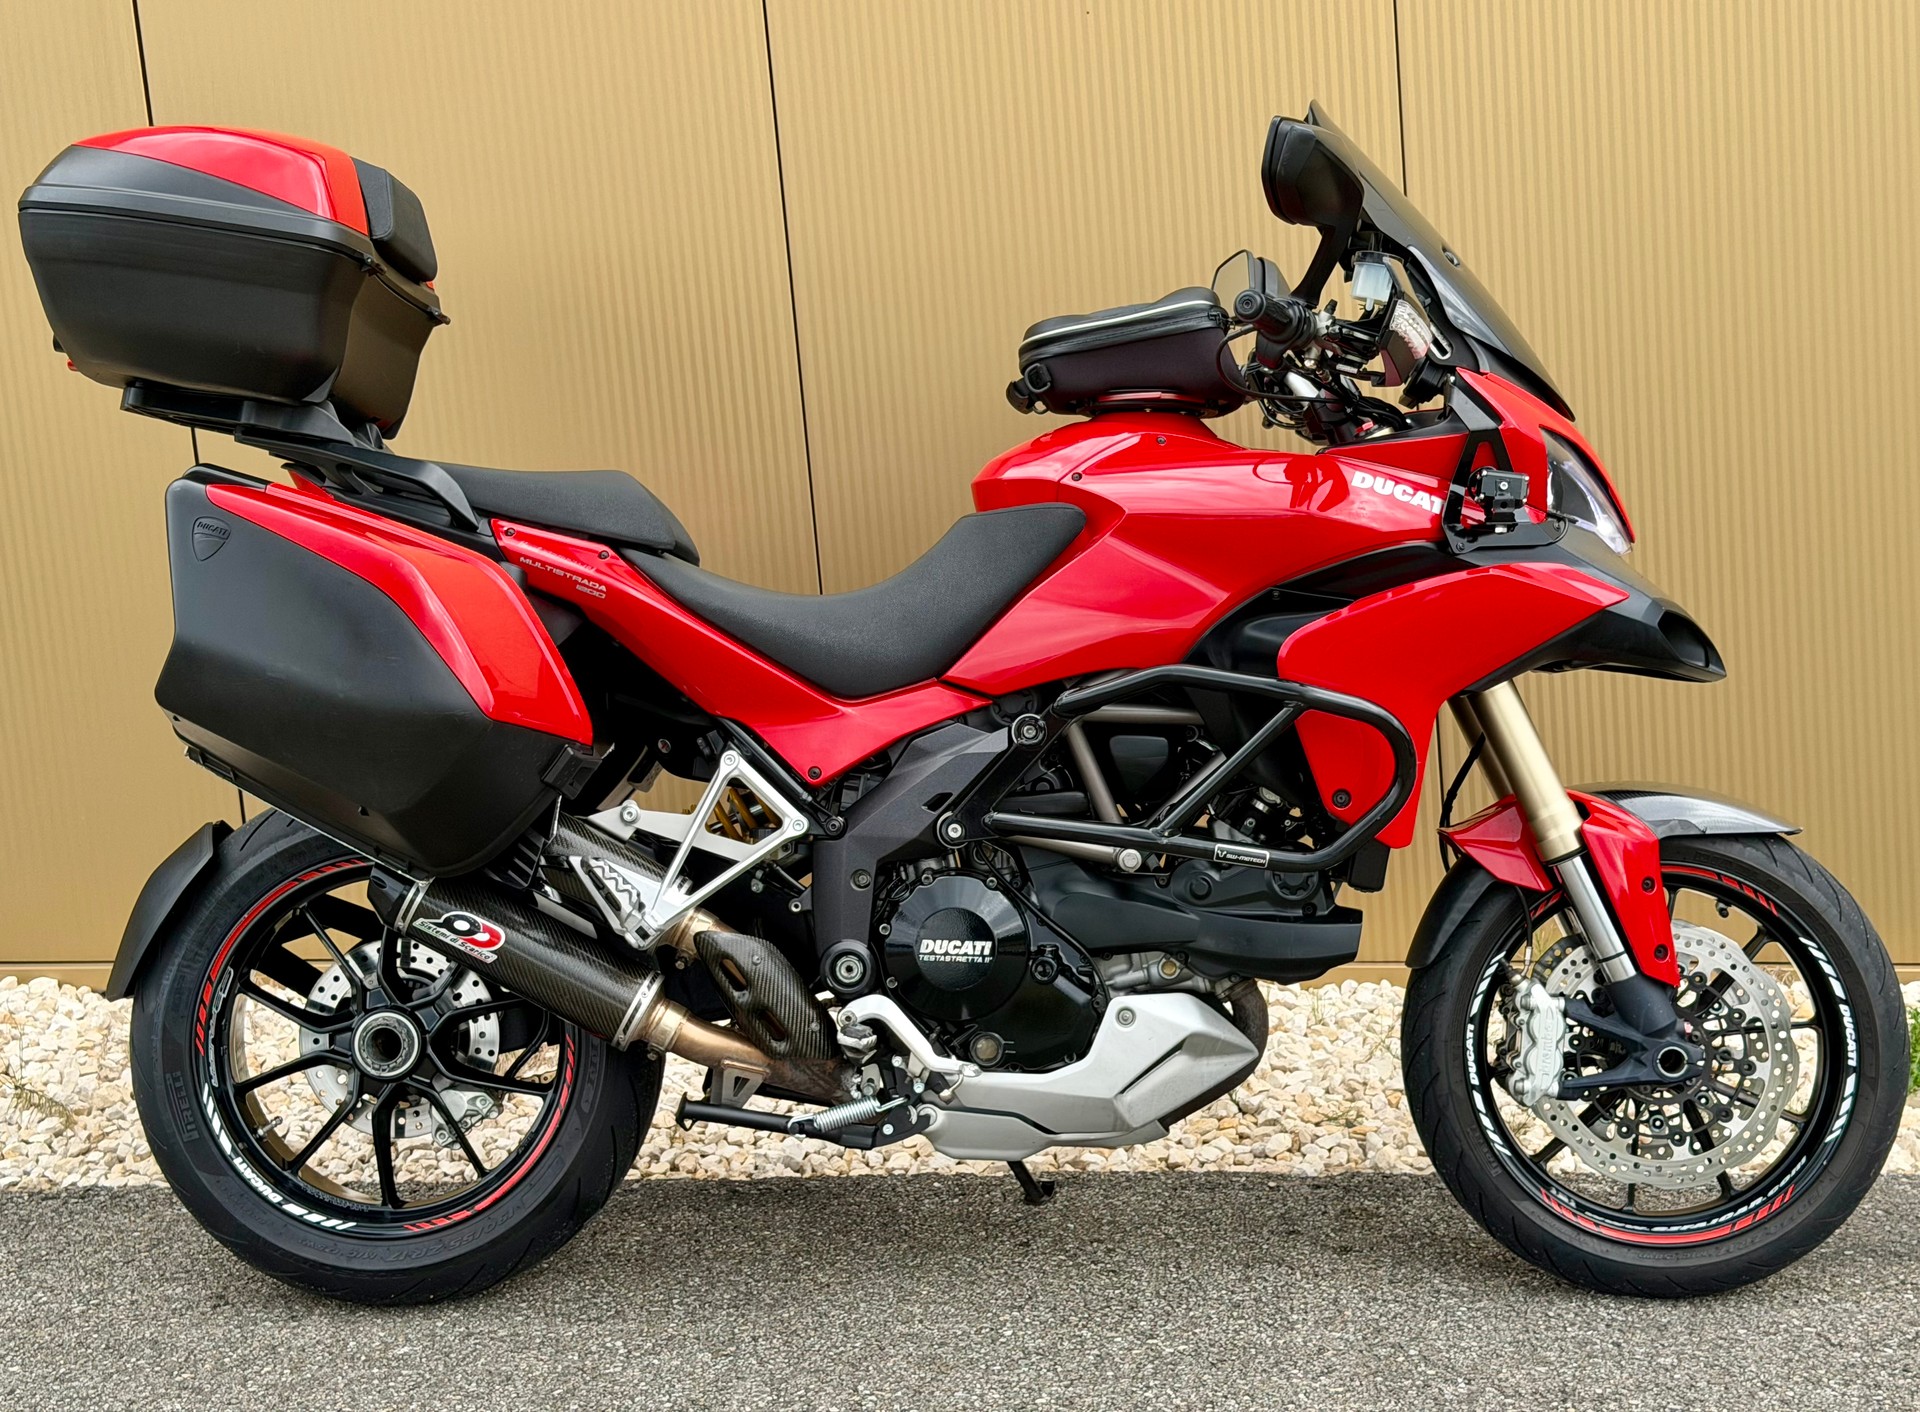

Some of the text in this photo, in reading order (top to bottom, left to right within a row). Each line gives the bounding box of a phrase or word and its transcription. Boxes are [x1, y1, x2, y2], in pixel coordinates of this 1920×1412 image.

[1351, 471, 1446, 515] DUCAT
[196, 521, 230, 536] DUCATI
[519, 556, 607, 592] MULTISTRADA
[1225, 853, 1266, 864] SW-MOTECH
[418, 920, 451, 940] Sistemi
[450, 936, 460, 944] di
[919, 954, 983, 964] TESTASTRETTA
[920, 939, 993, 956] DUCATI
[1839, 1004, 1858, 1067] DUCATI
[1465, 1023, 1480, 1086] DUCATI
[232, 1156, 284, 1204] DUCATI
